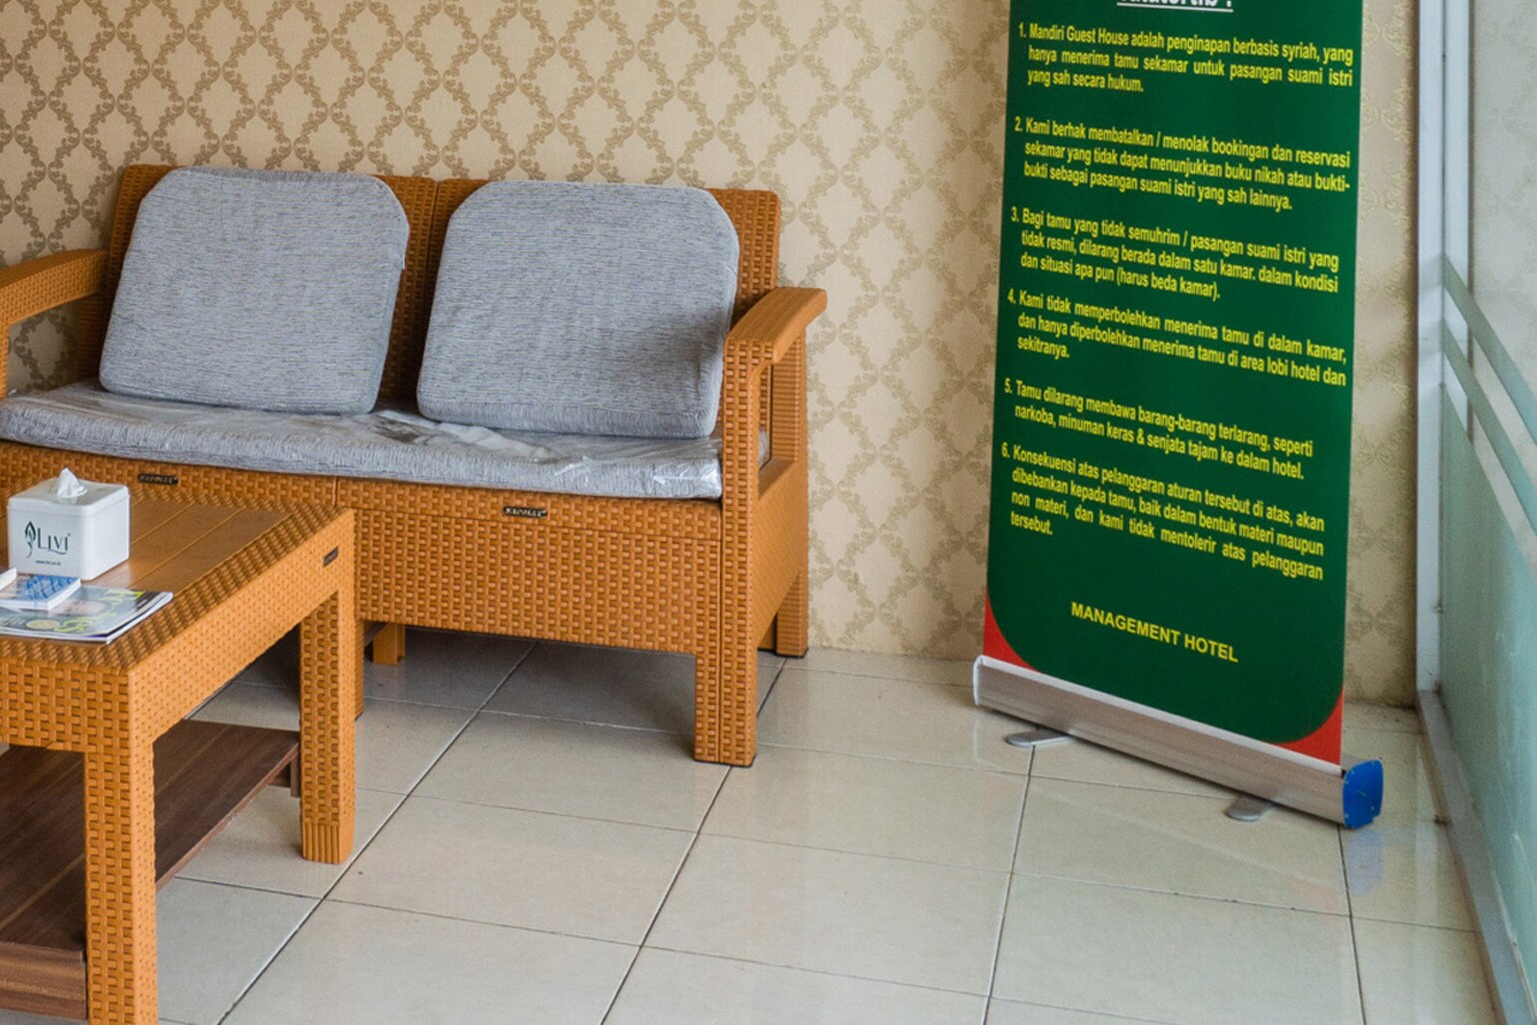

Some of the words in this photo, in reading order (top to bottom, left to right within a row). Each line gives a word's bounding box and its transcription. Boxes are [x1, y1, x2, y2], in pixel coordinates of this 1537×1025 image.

[1029, 22, 1065, 40] Mandiri
[1066, 25, 1097, 44] Guest
[1097, 28, 1130, 46] House
[1130, 31, 1165, 49] adalah
[1166, 34, 1231, 56] penginapan
[1232, 37, 1280, 57] berbasis
[1322, 47, 1354, 67] yang
[1029, 45, 1057, 66] hanya
[1061, 49, 1110, 67] menerima
[1114, 52, 1139, 69] tamu
[1143, 55, 1189, 73] sekamar
[1193, 59, 1225, 76] untuk
[1229, 64, 1283, 84] pasangan
[1287, 67, 1323, 84] suami
[1328, 68, 1353, 87] istri
[1027, 70, 1051, 88] yang
[1052, 69, 1071, 85] sah
[1072, 73, 1106, 89] secara
[1107, 73, 1144, 92] hukum.
[1025, 140, 1066, 159] sekamar
[1067, 147, 1092, 166] yang
[1093, 147, 1118, 165] tidak
[1119, 150, 1149, 171] dapat
[1150, 157, 1223, 178] menunjukkan
[1224, 161, 1252, 181] buku
[1254, 166, 1285, 185] nikah
[1286, 170, 1313, 189] atau
[1026, 117, 1050, 135] Kami
[1051, 120, 1086, 139] berhak
[1088, 127, 1154, 147] membatalkan
[1162, 135, 1209, 153] menolak
[1211, 136, 1269, 162] bookingan
[1271, 144, 1293, 162] dan
[1295, 150, 1351, 168] reservasi
[1024, 160, 1048, 179] bukti
[1049, 165, 1088, 187] sebagai
[1090, 172, 1138, 193] pasangan
[1140, 178, 1172, 195] suami
[1174, 179, 1196, 197] istri
[1197, 185, 1225, 206] yang
[1227, 187, 1247, 204] sah
[1249, 188, 1292, 213] lainnya.
[1021, 230, 1045, 248] tidak
[1046, 236, 1077, 255] resmi,
[1079, 238, 1120, 264] dilarang
[1121, 244, 1156, 266] berada
[1157, 250, 1192, 271] dalam
[1193, 258, 1218, 275] satu
[1258, 265, 1293, 286] dalam
[1294, 270, 1339, 293] kondisi
[1022, 207, 1044, 230] Bagi
[1046, 212, 1072, 230] tamu
[1073, 219, 1099, 238] yang
[1101, 219, 1126, 238] tidak
[1190, 235, 1244, 258] pasangan
[1246, 243, 1281, 260] suami
[1283, 244, 1306, 264] istri
[1309, 252, 1339, 274] yang
[1020, 252, 1039, 269] dan
[1040, 255, 1073, 275] situasi
[1074, 263, 1094, 280] apa
[1094, 266, 1115, 283] pun
[1116, 267, 1149, 288] (harus
[1150, 272, 1178, 292] beda
[1179, 276, 1220, 302] kamar).
[1018, 312, 1036, 329] dan
[1038, 315, 1068, 338] hanya
[1069, 321, 1141, 349] diperbolehkan
[1142, 337, 1196, 359] menerima
[1197, 344, 1226, 365] tamu
[1227, 349, 1239, 367] di
[1240, 355, 1265, 372] area
[1267, 356, 1289, 376] lobi
[1290, 360, 1321, 382] hotel
[1322, 366, 1347, 387] dan
[1019, 290, 1044, 309] Kami
[1046, 295, 1071, 314] tidak
[1074, 303, 1161, 330] memperbolehkan
[1164, 318, 1219, 340] menerima
[1221, 325, 1250, 346] tamu
[1252, 330, 1265, 348] di
[1267, 333, 1303, 355] dalam
[1306, 339, 1347, 365] kamar,
[1015, 405, 1056, 427] narkoba,
[1058, 413, 1105, 436] minuman
[1106, 421, 1135, 443] keras
[1146, 433, 1186, 455] senjata
[1187, 439, 1219, 462] tajam
[1220, 445, 1235, 465] ke
[1235, 450, 1270, 472] dalam
[1272, 457, 1304, 480] hotel.
[1016, 379, 1042, 400] Tamu
[1043, 386, 1084, 413] dilarang
[1085, 398, 1136, 421] membawa
[1138, 405, 1217, 441] barang-barang
[1273, 436, 1313, 457] seperti
[1012, 467, 1069, 494] dibebankan
[1070, 480, 1107, 504] kepada
[1108, 490, 1137, 513] tamu,
[1138, 496, 1162, 517] baik
[1163, 503, 1197, 525] dalam
[1198, 510, 1237, 535] bentuk
[1238, 523, 1275, 544] materi
[1276, 533, 1324, 556] maupun
[1013, 444, 1076, 474] Konsekuensi
[1077, 461, 1100, 480] atas
[1101, 468, 1165, 495] pelanggaran
[1166, 482, 1202, 503] aturan
[1204, 489, 1251, 515] tersebut
[1252, 500, 1264, 518] di
[1265, 505, 1293, 527] atas,
[1295, 511, 1325, 532] akan
[1010, 511, 1053, 535] tersebut.
[1011, 491, 1030, 507] non
[1035, 497, 1069, 518] materi,
[1074, 504, 1094, 523] dan
[1099, 509, 1124, 531] kami
[1128, 517, 1155, 539] tidak
[1221, 542, 1246, 561] atas
[1251, 550, 1324, 580] pelanggaran
[1071, 601, 1181, 646] MANAGEMENT
[1184, 633, 1239, 663] HOTEL
